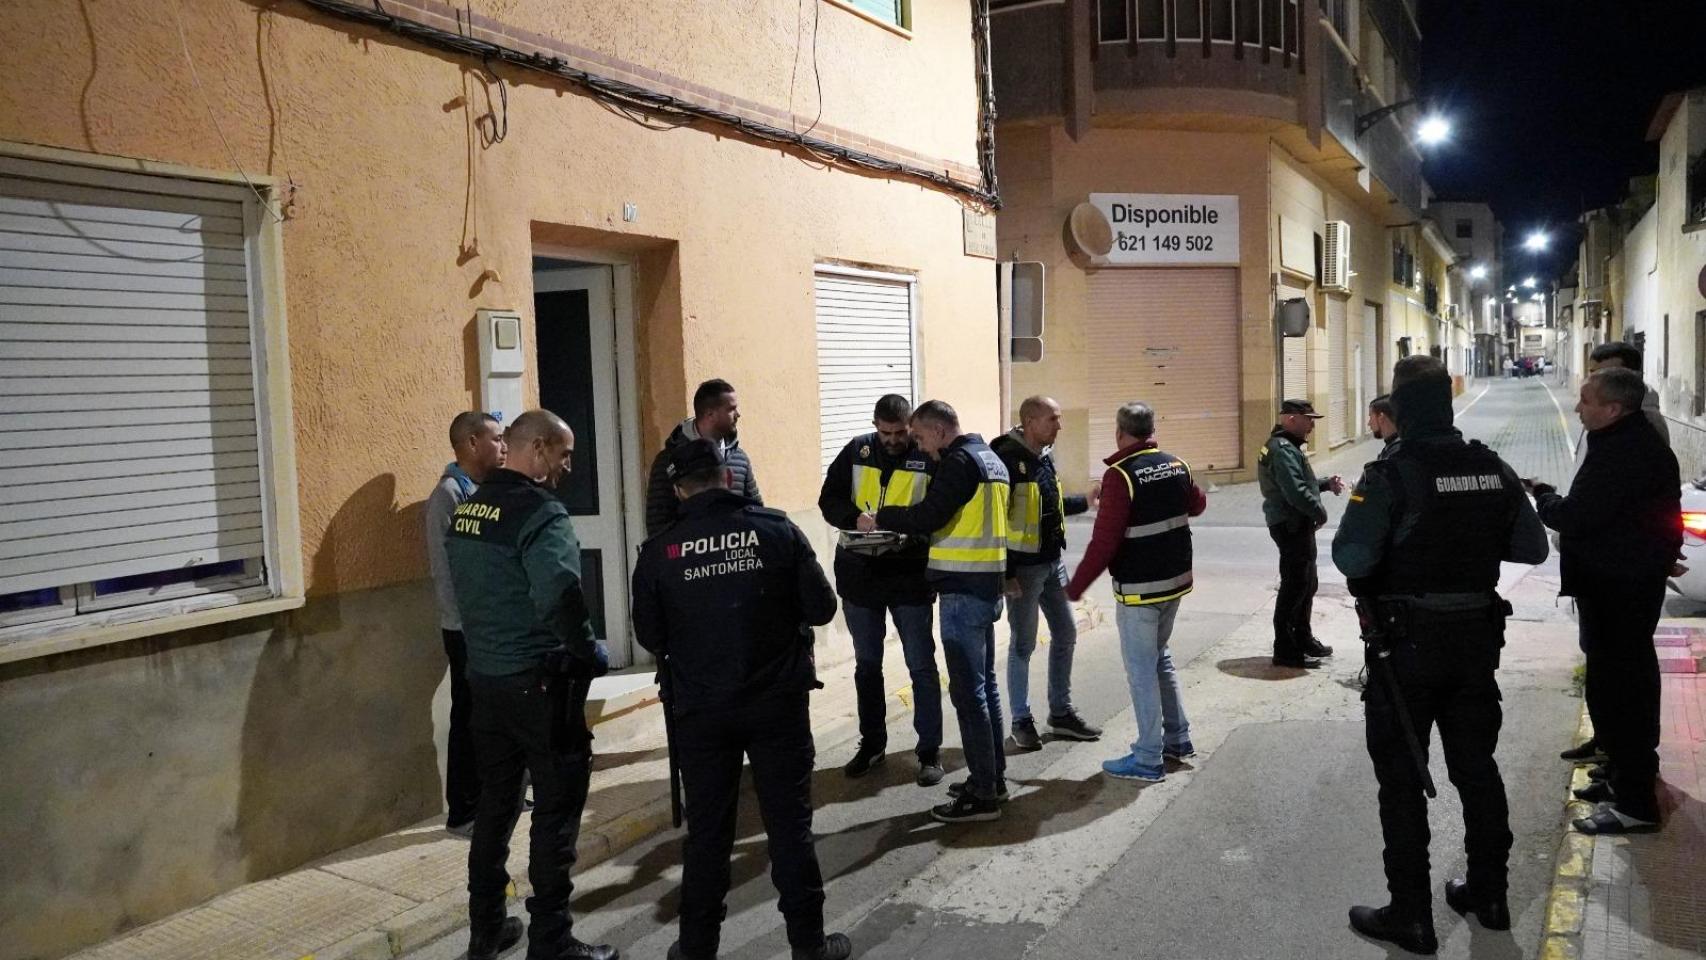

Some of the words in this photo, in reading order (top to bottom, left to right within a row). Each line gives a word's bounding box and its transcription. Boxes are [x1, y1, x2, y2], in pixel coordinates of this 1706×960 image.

[1112, 203, 1218, 228] Disponible
[1118, 235, 1146, 251] 621
[1153, 235, 1180, 251] 149
[1186, 236, 1213, 251] 502
[1139, 468, 1185, 484] NACIONAL
[1436, 476, 1479, 493] GUARDIA
[1479, 474, 1503, 490] CIVIL
[455, 518, 480, 535] CIVIL
[681, 530, 759, 557] POLICIA
[725, 547, 756, 561] LOCAL
[684, 558, 764, 581] SANTOMERA
